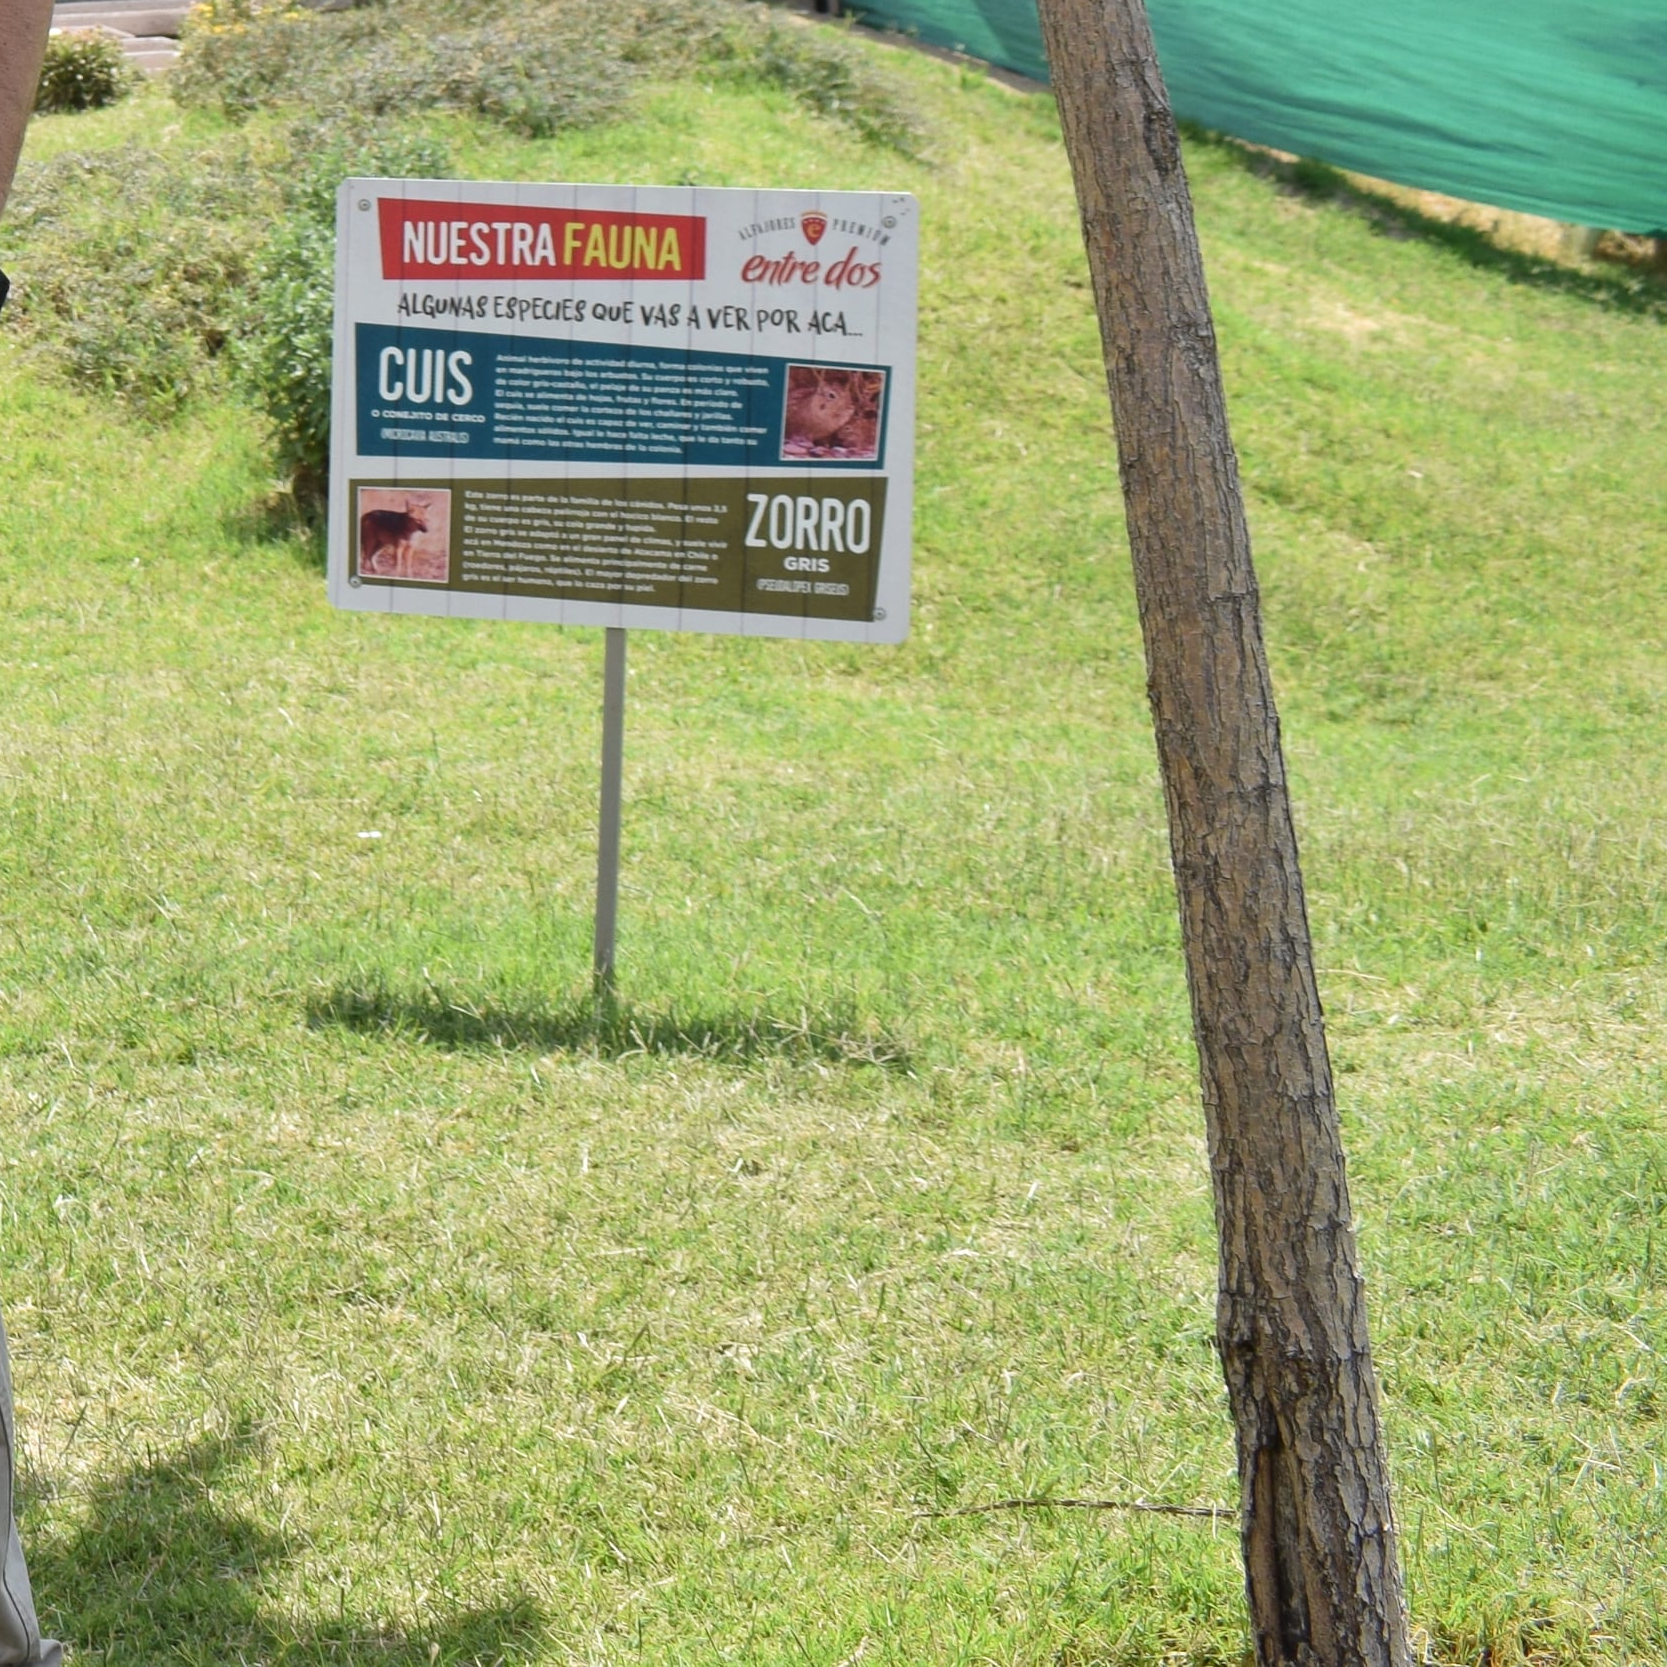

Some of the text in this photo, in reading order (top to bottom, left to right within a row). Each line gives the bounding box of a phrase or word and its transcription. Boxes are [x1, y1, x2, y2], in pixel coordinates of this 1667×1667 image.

[403, 221, 682, 272] NUESTRA FAUNA
[738, 217, 795, 241] ALFAJORES
[832, 218, 891, 246] PREMIUM
[741, 245, 882, 290] entre dos
[397, 293, 486, 320] ALGUNAS
[493, 296, 587, 323] ESPECIES
[592, 301, 634, 324] QUE
[640, 304, 680, 327] VAS
[687, 304, 701, 327] A
[707, 306, 749, 333] VER
[757, 309, 798, 334] POR
[378, 346, 474, 406] CUIS
[745, 494, 871, 554] ZORRO
[783, 556, 830, 573] GRIS
